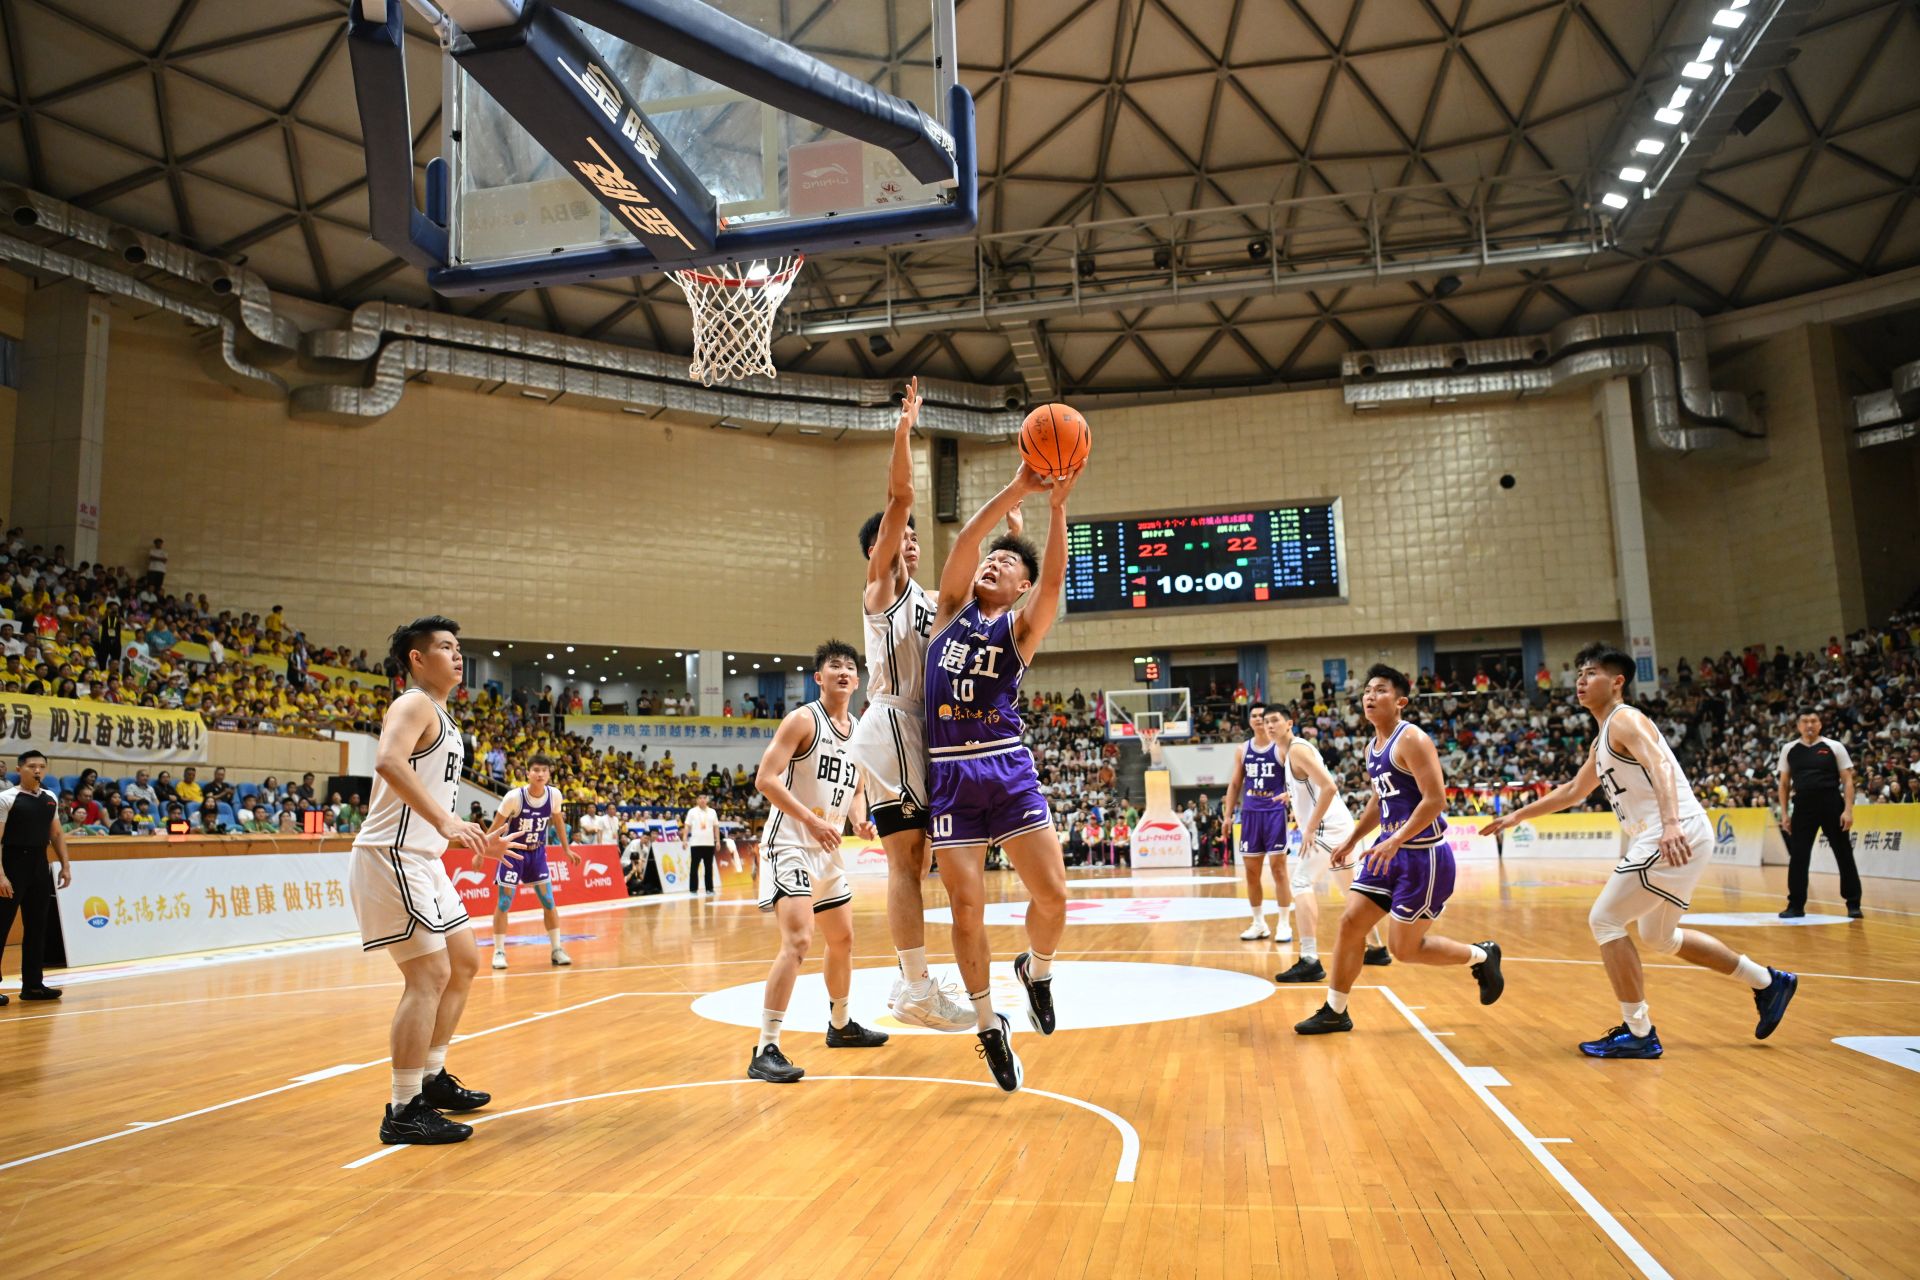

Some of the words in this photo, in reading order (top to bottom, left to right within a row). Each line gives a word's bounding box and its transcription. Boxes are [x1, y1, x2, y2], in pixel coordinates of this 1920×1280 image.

[557, 56, 677, 195] 金陵
[1138, 543, 1168, 558] 22
[1227, 536, 1257, 552] 22
[1156, 571, 1243, 594] 10:00
[938, 637, 1004, 679] 湛江
[952, 678, 975, 702] 10
[1253, 777, 1264, 789] 14
[830, 787, 844, 807] 18
[932, 813, 953, 838] 10
[525, 832, 540, 844] 23
[1137, 832, 1182, 843] LI-NING
[504, 870, 519, 884] 23
[584, 876, 612, 889] LI-NING
[794, 868, 810, 888] 18
[204, 882, 277, 919] 为健康
[282, 878, 345, 913] 做好药
[460, 886, 491, 902] I-NING
